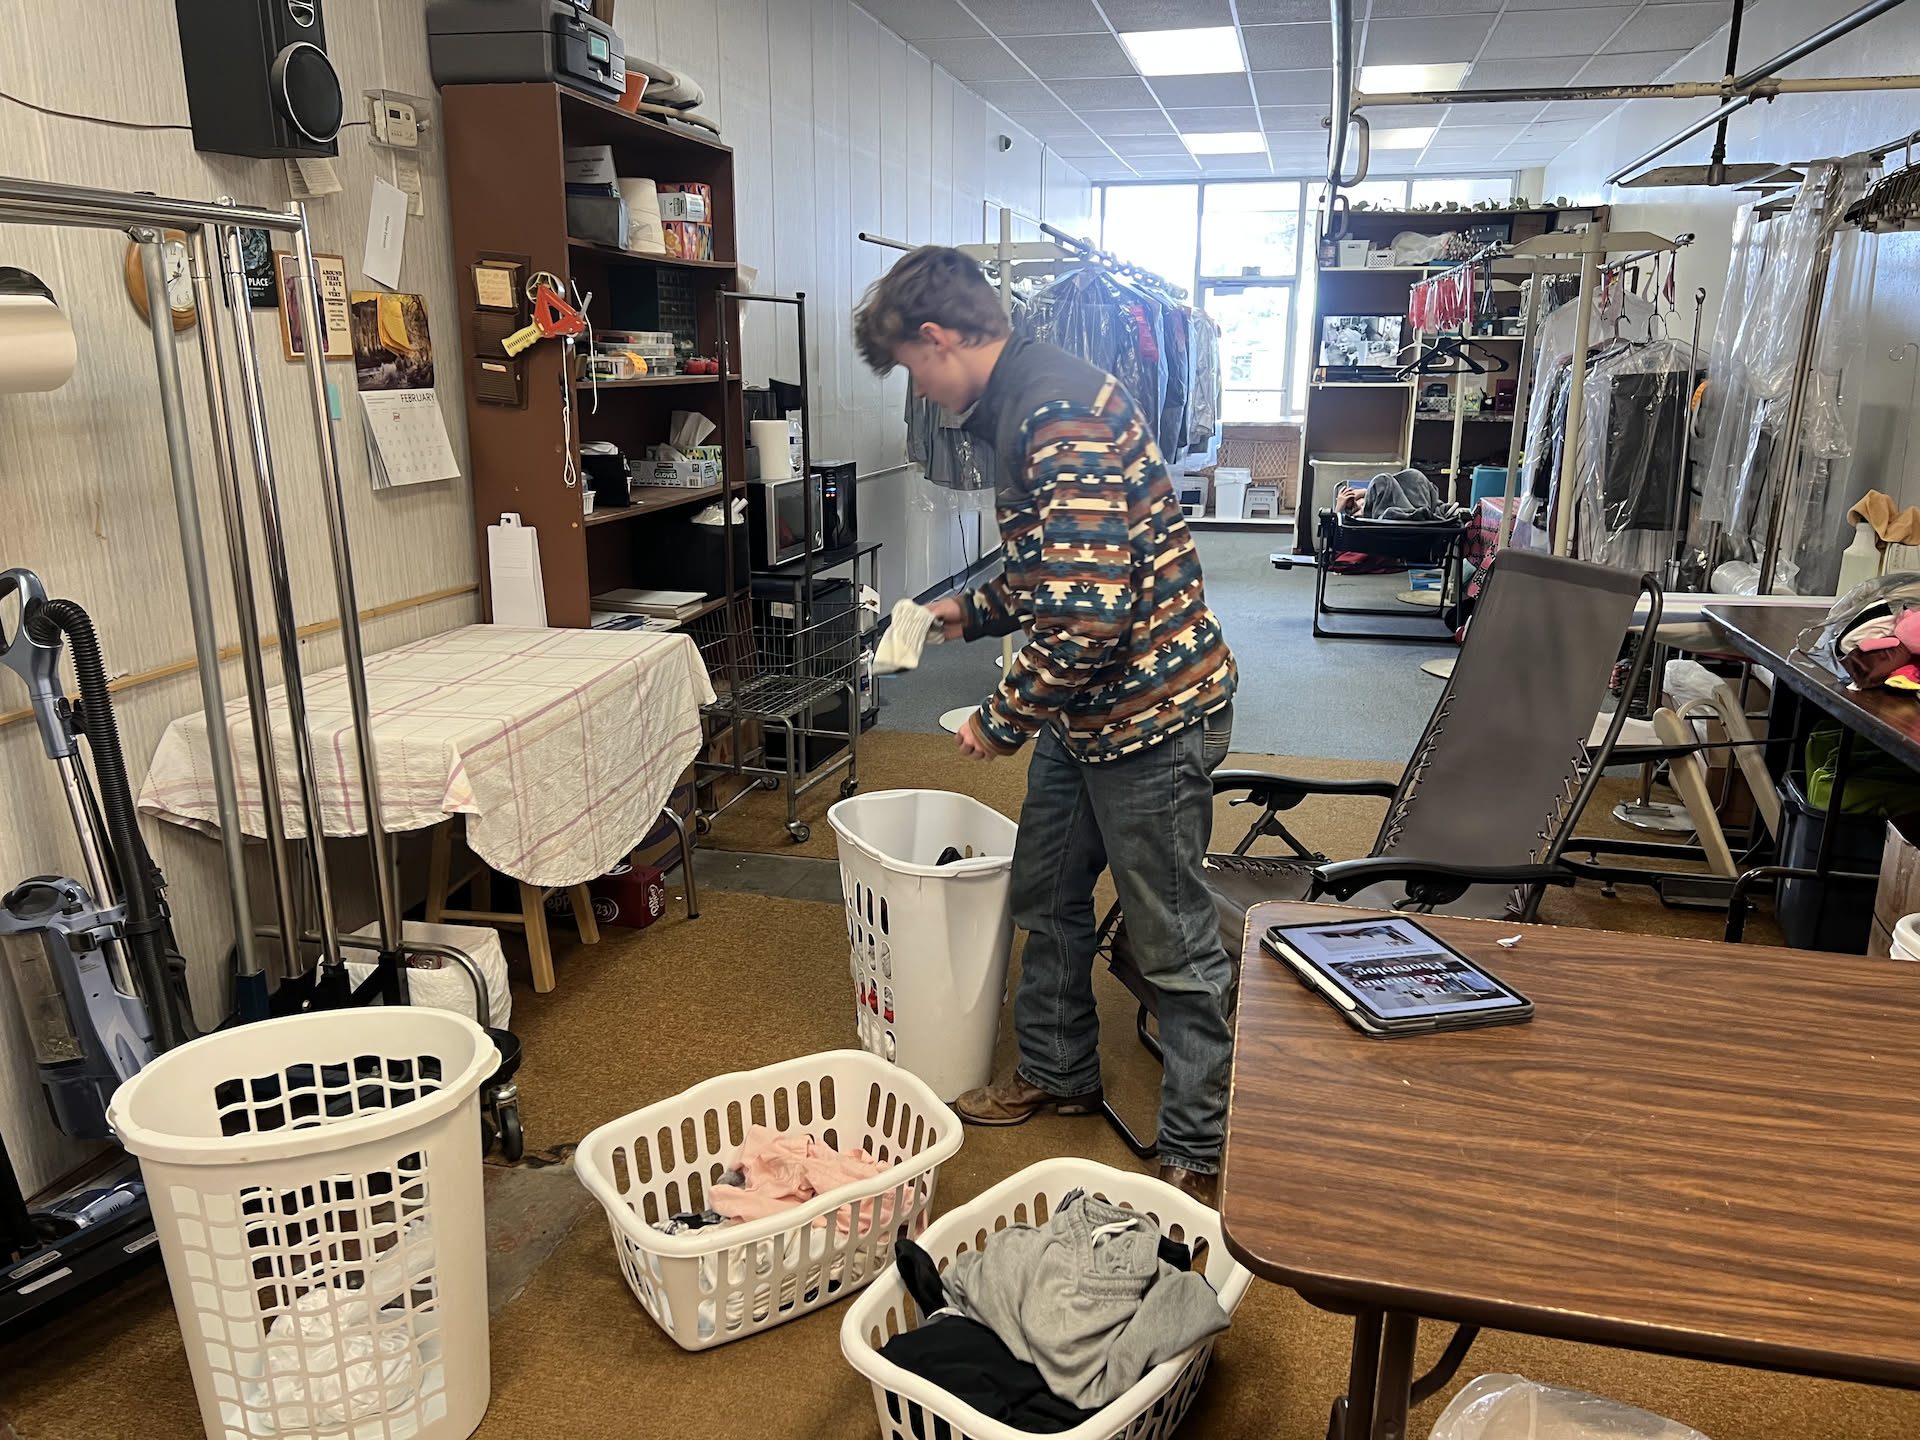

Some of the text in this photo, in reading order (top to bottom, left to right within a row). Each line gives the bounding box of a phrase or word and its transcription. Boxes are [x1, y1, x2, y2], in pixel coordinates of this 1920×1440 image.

[248, 277, 269, 287] PLACE
[400, 393, 434, 403] FEBRUARY
[1352, 961, 1448, 976] Photoblog
[1411, 984, 1452, 996] The
